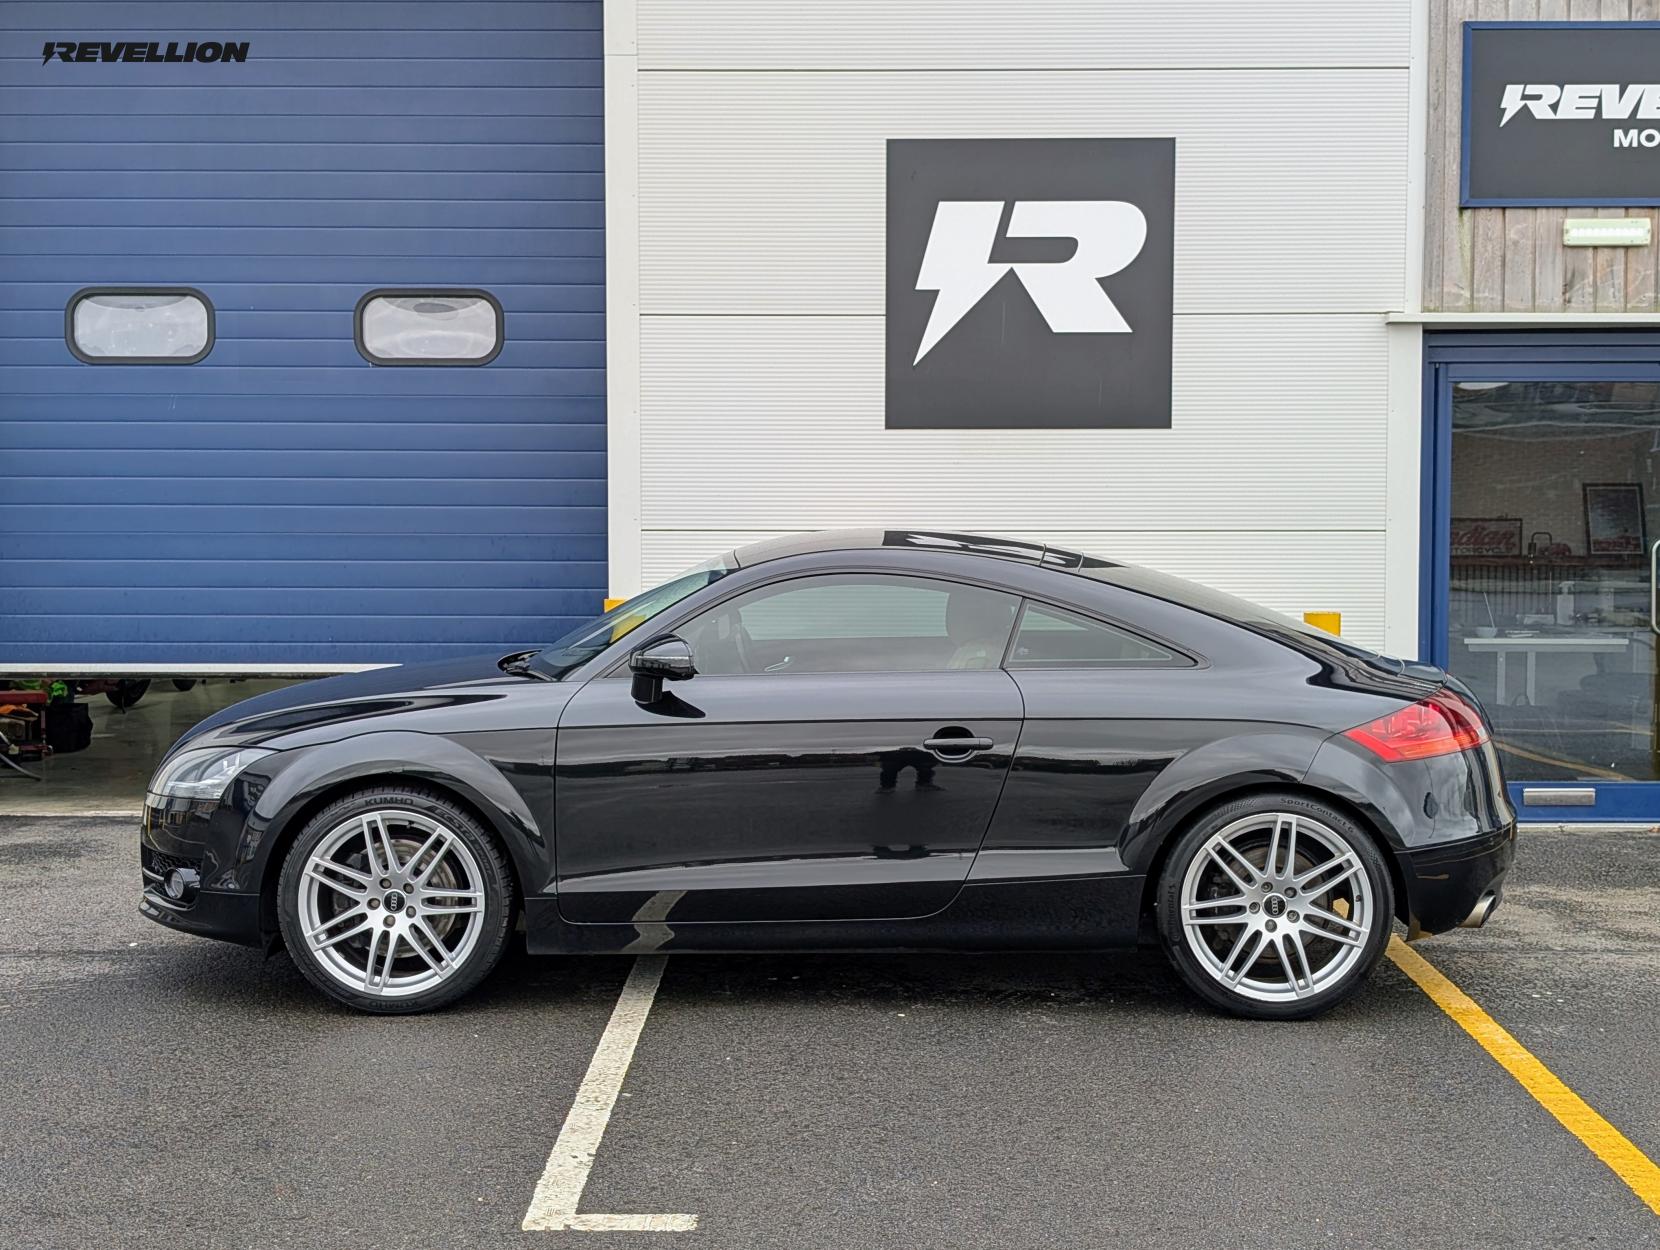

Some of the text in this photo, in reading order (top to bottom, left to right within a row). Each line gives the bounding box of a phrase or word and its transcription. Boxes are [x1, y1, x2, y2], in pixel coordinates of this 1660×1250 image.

[1613, 128, 1660, 147] MO
[365, 797, 414, 806] KUMHO
[1280, 797, 1347, 827] SportContact
